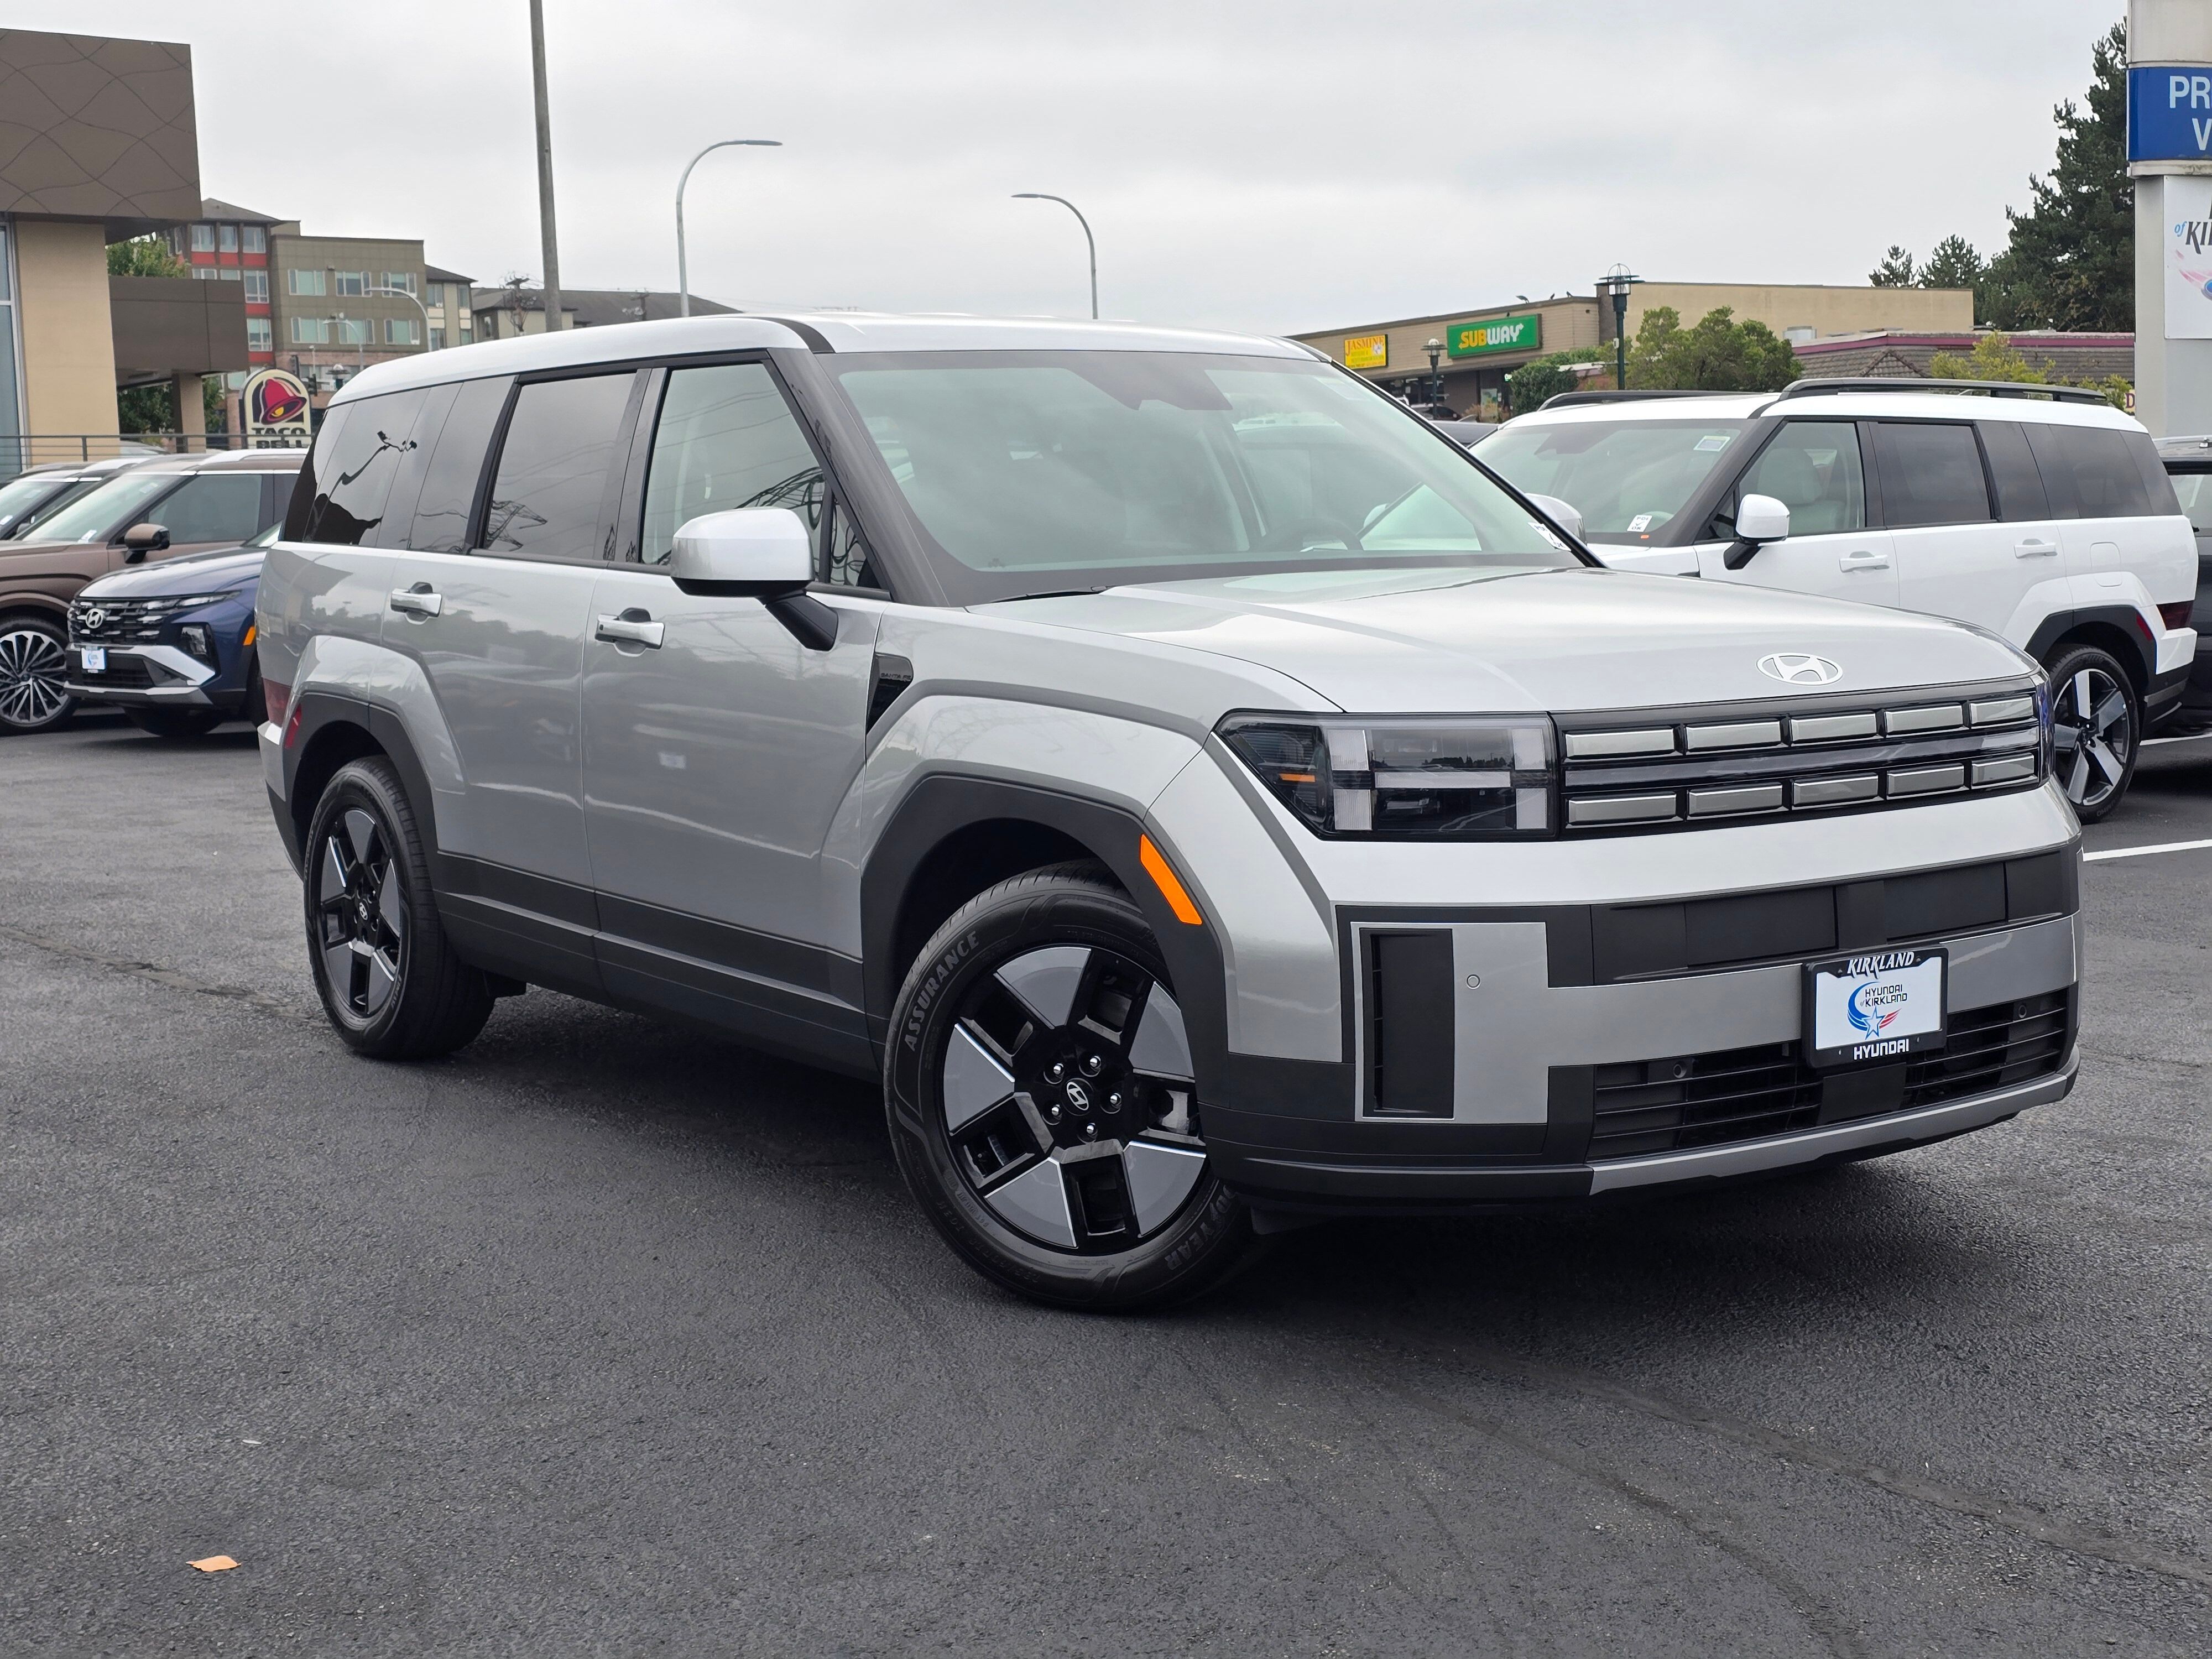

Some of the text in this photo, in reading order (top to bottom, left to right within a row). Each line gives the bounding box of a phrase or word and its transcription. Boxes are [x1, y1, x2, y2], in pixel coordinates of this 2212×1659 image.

[2169, 75, 2212, 109] PR
[2174, 221, 2212, 255] of KI
[1346, 336, 1385, 357] JASMINE
[1459, 324, 1524, 349] SUBWAY
[251, 427, 306, 436] TACO
[256, 440, 308, 448] BELL
[1847, 951, 1914, 979] KIRKLAND
[904, 930, 979, 1052] ASSURANCE
[1865, 984, 1903, 997] HYUNDAI
[1865, 993, 1907, 1008] KIRKLAND
[1854, 1039, 1910, 1061] HYUNDAI
